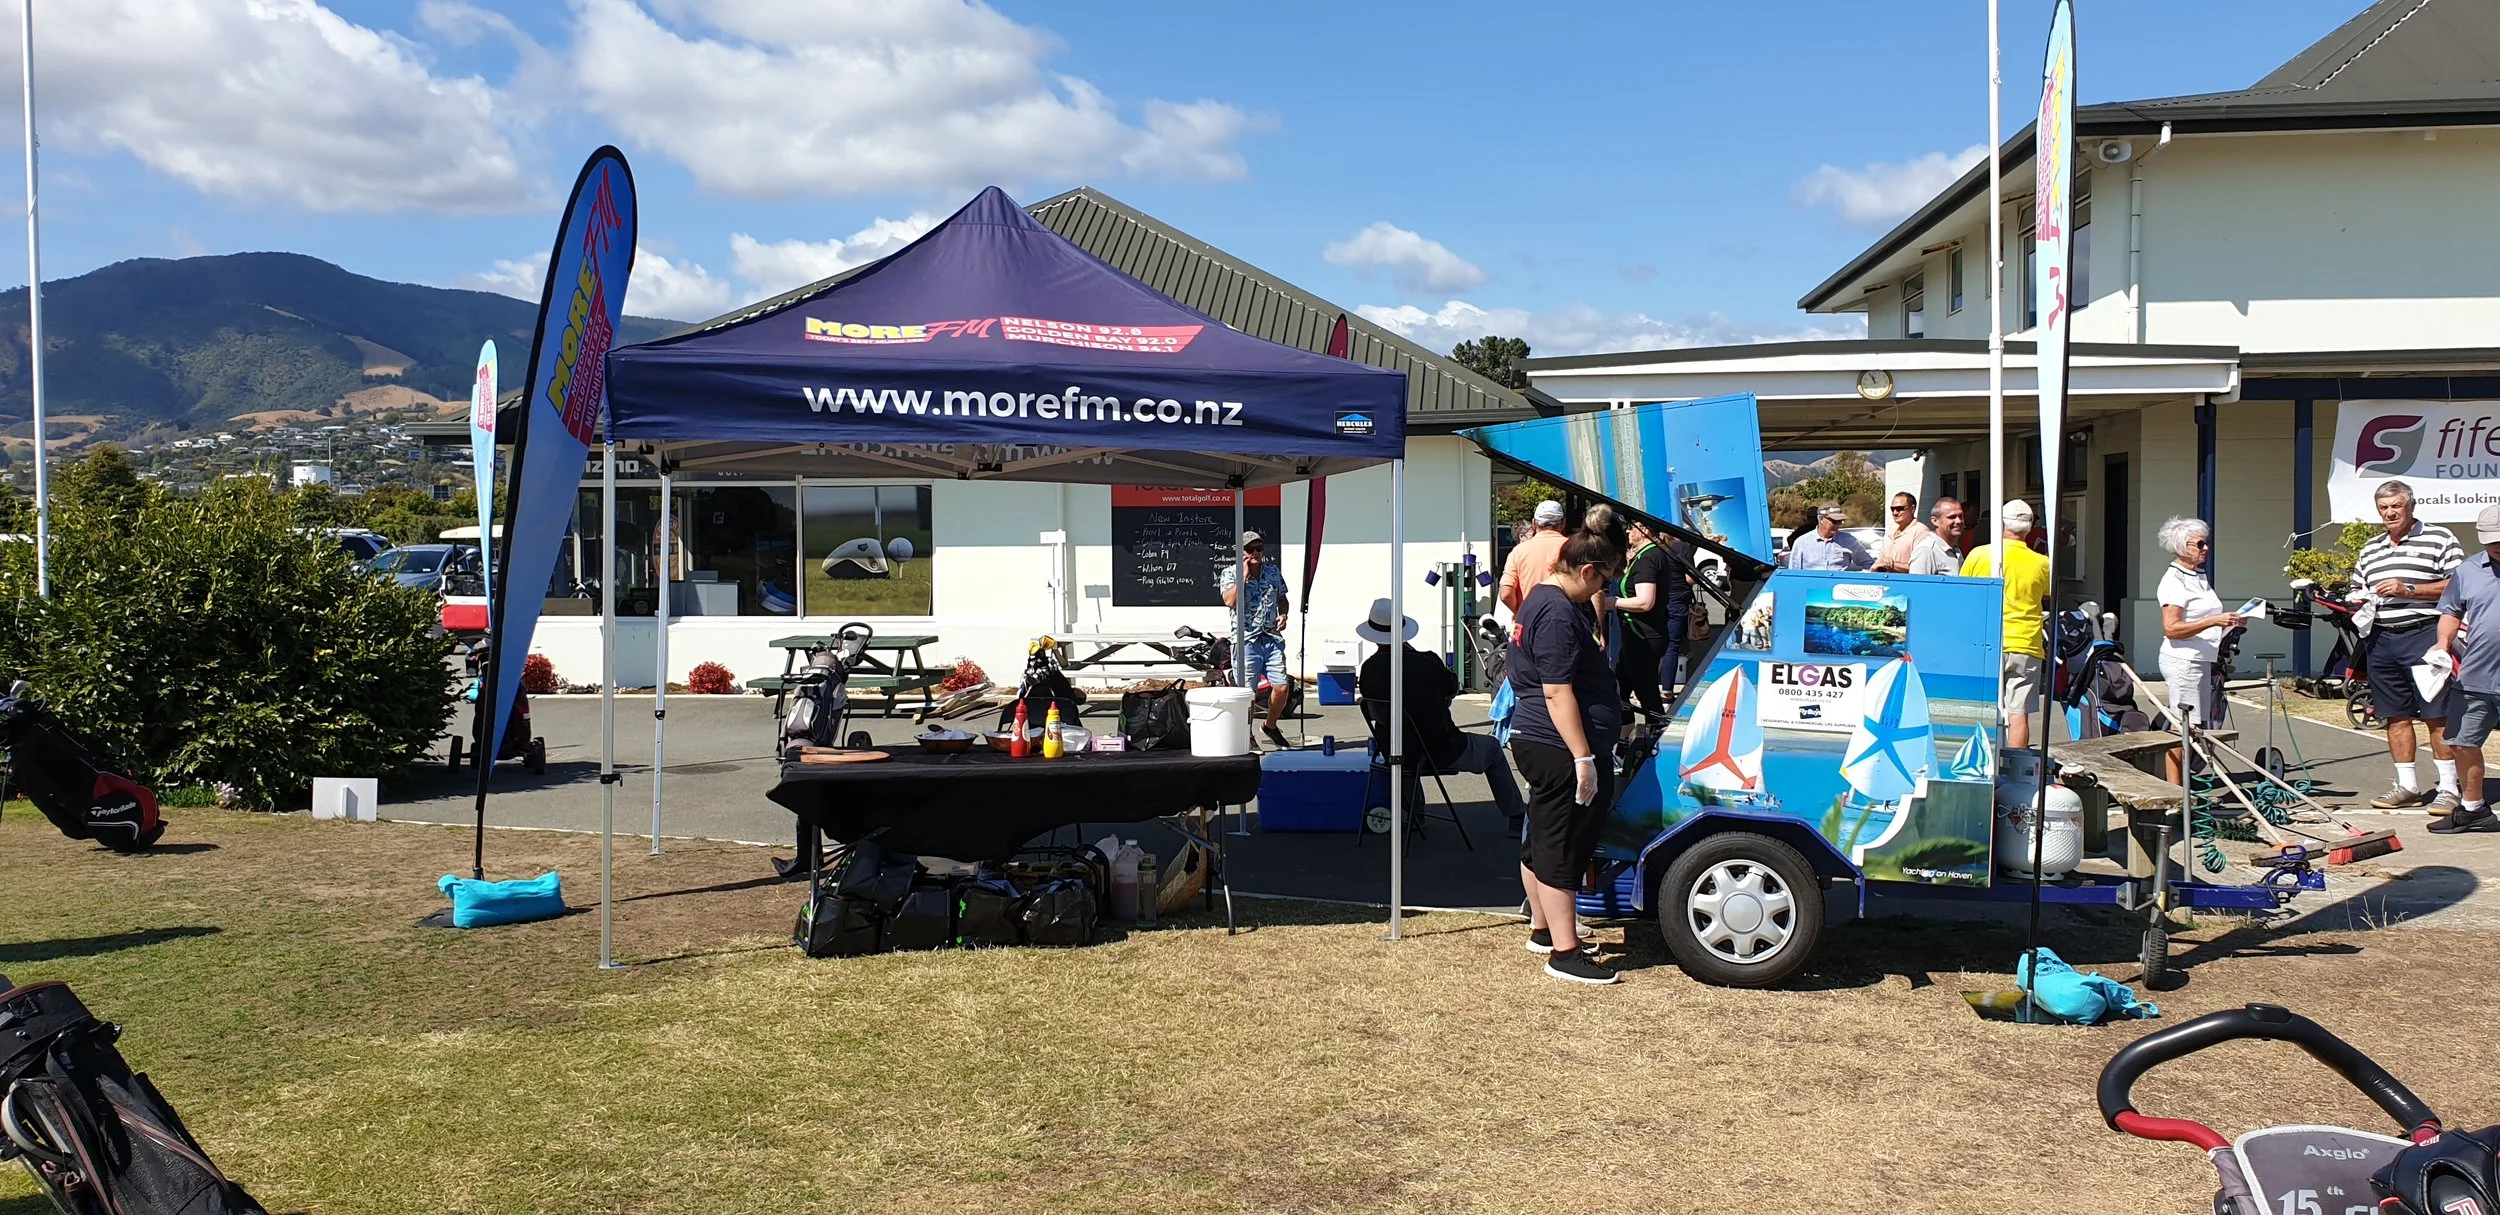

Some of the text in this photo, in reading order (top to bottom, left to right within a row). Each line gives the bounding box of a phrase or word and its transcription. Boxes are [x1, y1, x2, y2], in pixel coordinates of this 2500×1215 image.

[547, 163, 623, 416] MORE FM
[806, 316, 998, 339] MORE FM
[1004, 318, 1092, 333] NELSON
[1006, 326, 1178, 345] GOLDEN BAY 92.0
[1008, 333, 1134, 352] MURCHISON
[571, 348, 587, 397] NELSON
[585, 327, 611, 428] MURCHISON 94.1
[573, 368, 590, 421] GOLDEN
[587, 344, 596, 369] BAY
[803, 386, 1244, 426] www.morefm.co.nz
[585, 460, 639, 473] IZNO
[1162, 495, 1230, 503] www.totalgolf.co.nz
[2415, 493, 2451, 504] ocals
[1149, 512, 1170, 523] New
[1771, 664, 1852, 688] ELGAS
[1778, 688, 1802, 696] 0800
[1805, 690, 1823, 698] 435
[1902, 866, 1934, 878] Yachg
[1948, 870, 1973, 879] Haven
[2327, 1185, 2346, 1196] th
